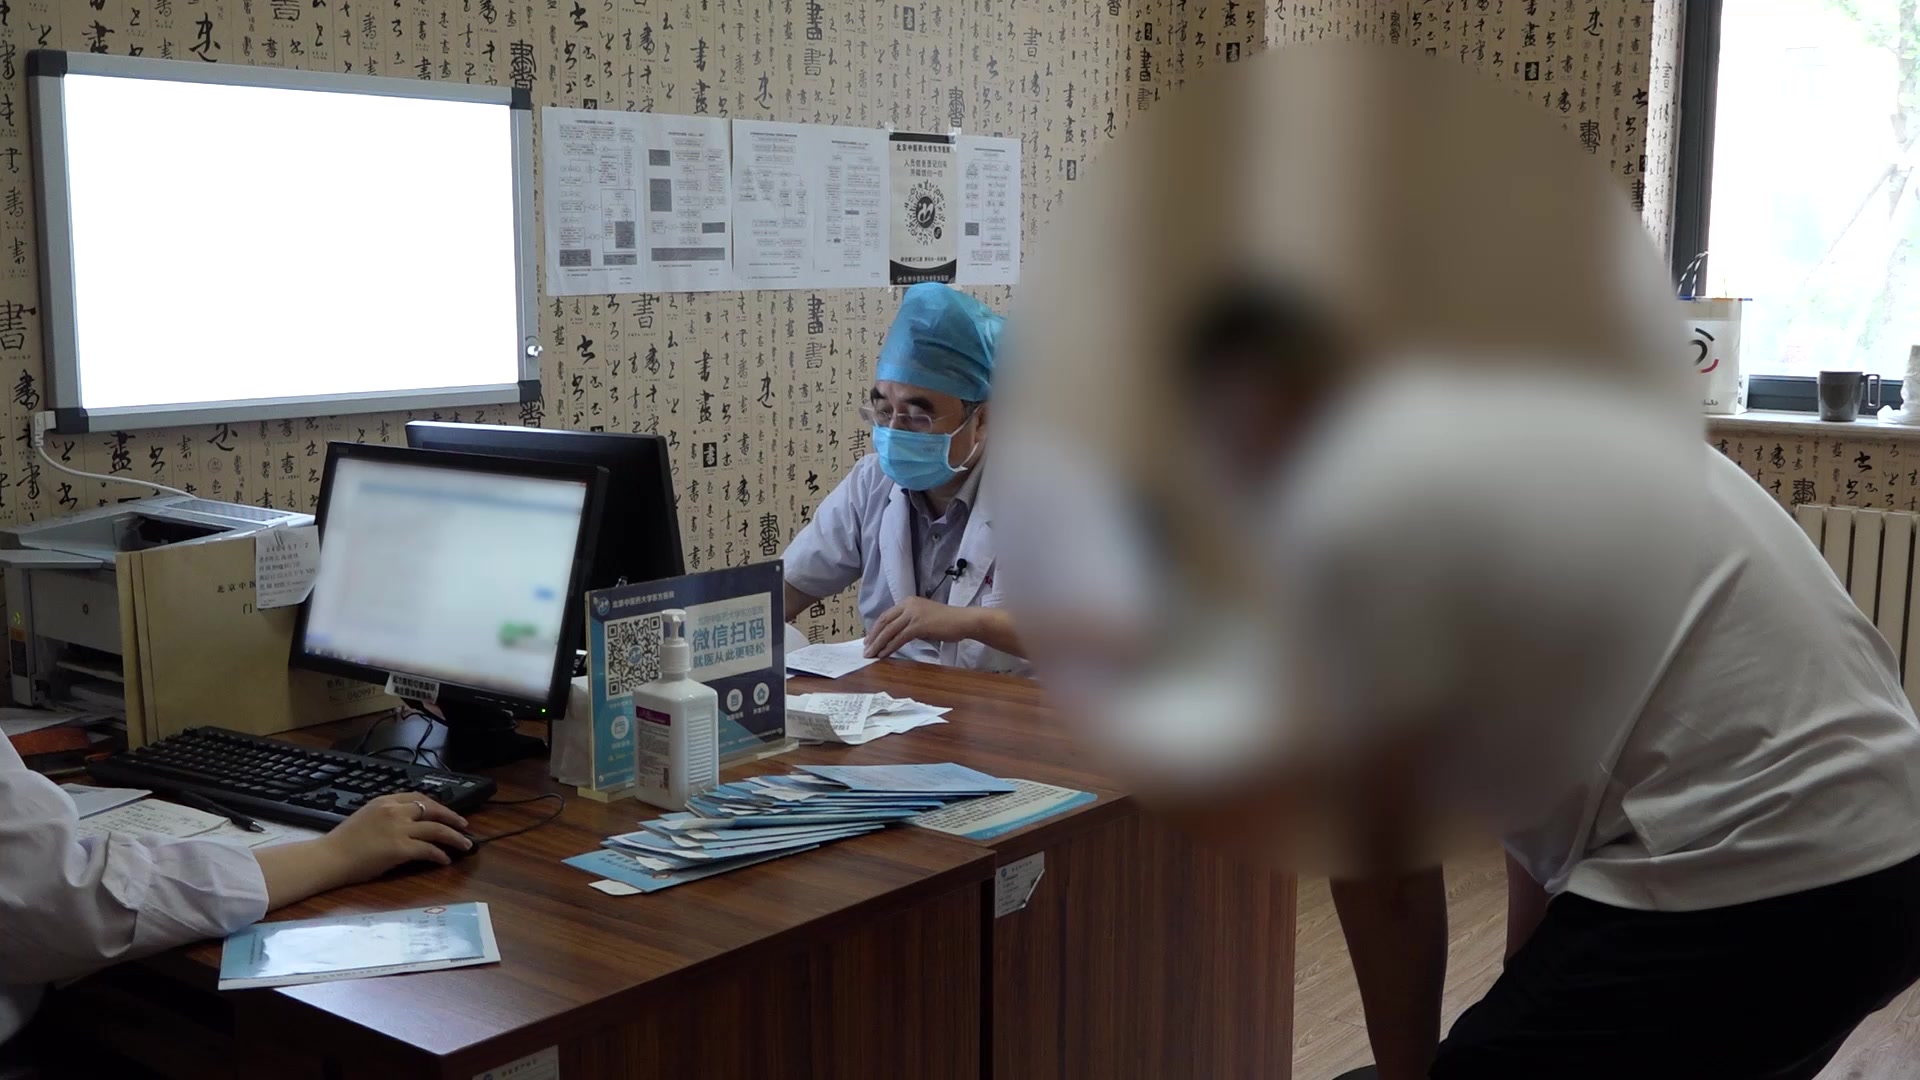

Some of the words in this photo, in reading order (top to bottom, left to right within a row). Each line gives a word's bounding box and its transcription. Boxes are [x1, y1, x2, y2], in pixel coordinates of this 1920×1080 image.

[612, 591, 675, 609] 北京中医药大学东方医院
[693, 618, 765, 653] 微信扫码
[693, 642, 765, 669] 就医从此更轻松
